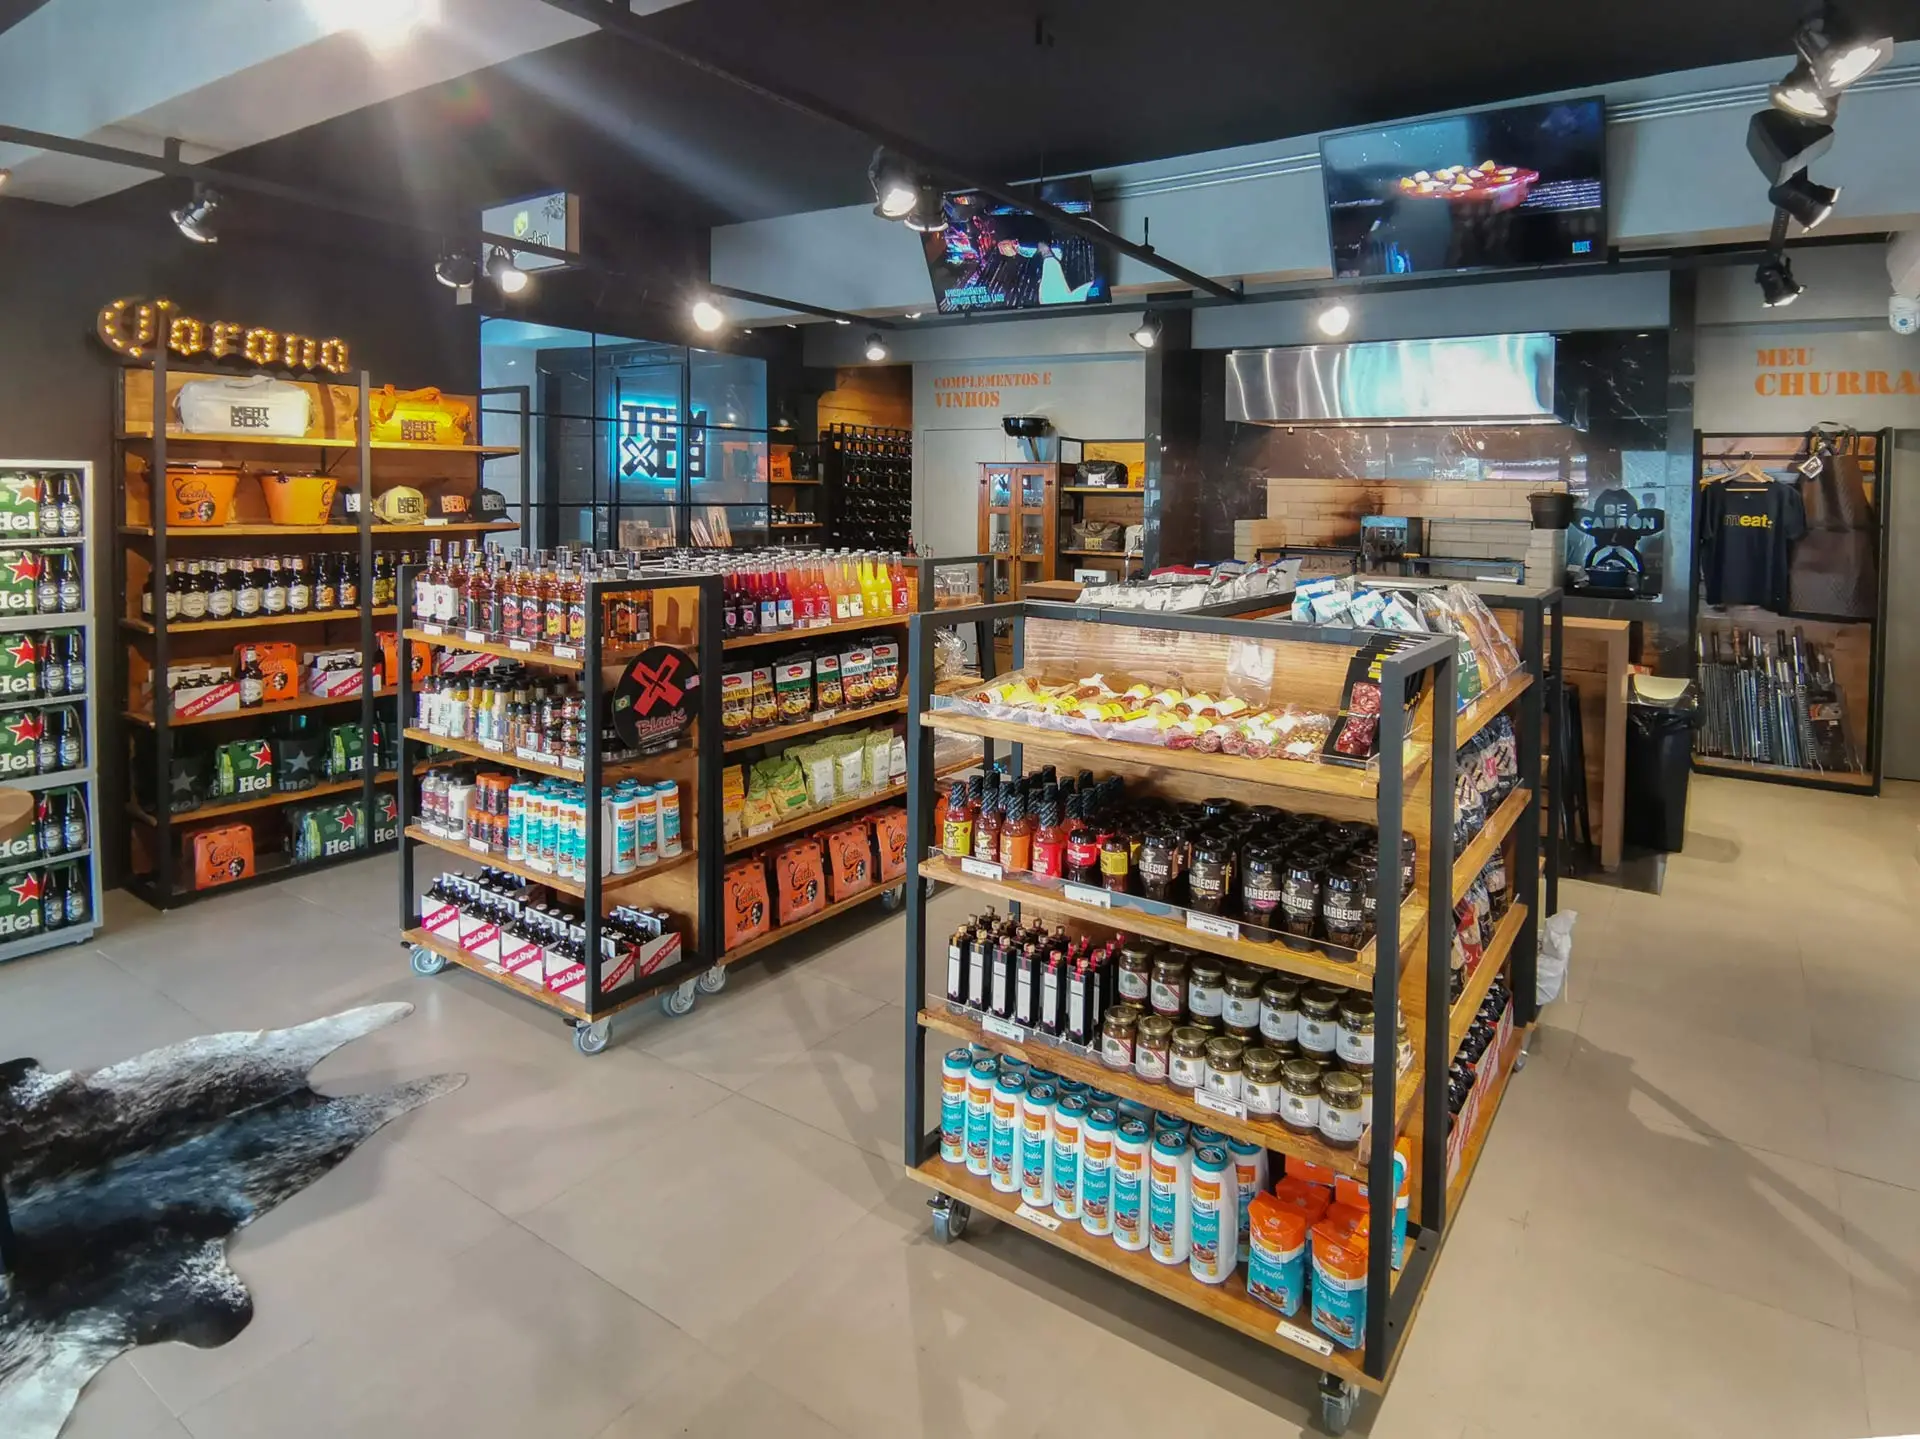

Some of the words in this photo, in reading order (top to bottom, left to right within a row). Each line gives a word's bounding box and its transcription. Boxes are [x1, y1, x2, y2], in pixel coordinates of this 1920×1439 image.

[97, 296, 350, 374] Corona
[1756, 347, 1815, 367] MEU
[934, 373, 1039, 389] COMPLEMENTOS
[1043, 372, 1052, 385] E
[1755, 369, 1920, 397] CHURRA
[935, 391, 1001, 409] VINHOS
[231, 406, 269, 417] MEAT
[231, 416, 269, 428] BOX
[401, 419, 437, 431] MEAT
[401, 430, 437, 442] BOX
[635, 707, 688, 737] Black
[238, 772, 272, 793] Hei
[324, 835, 356, 856] Hei
